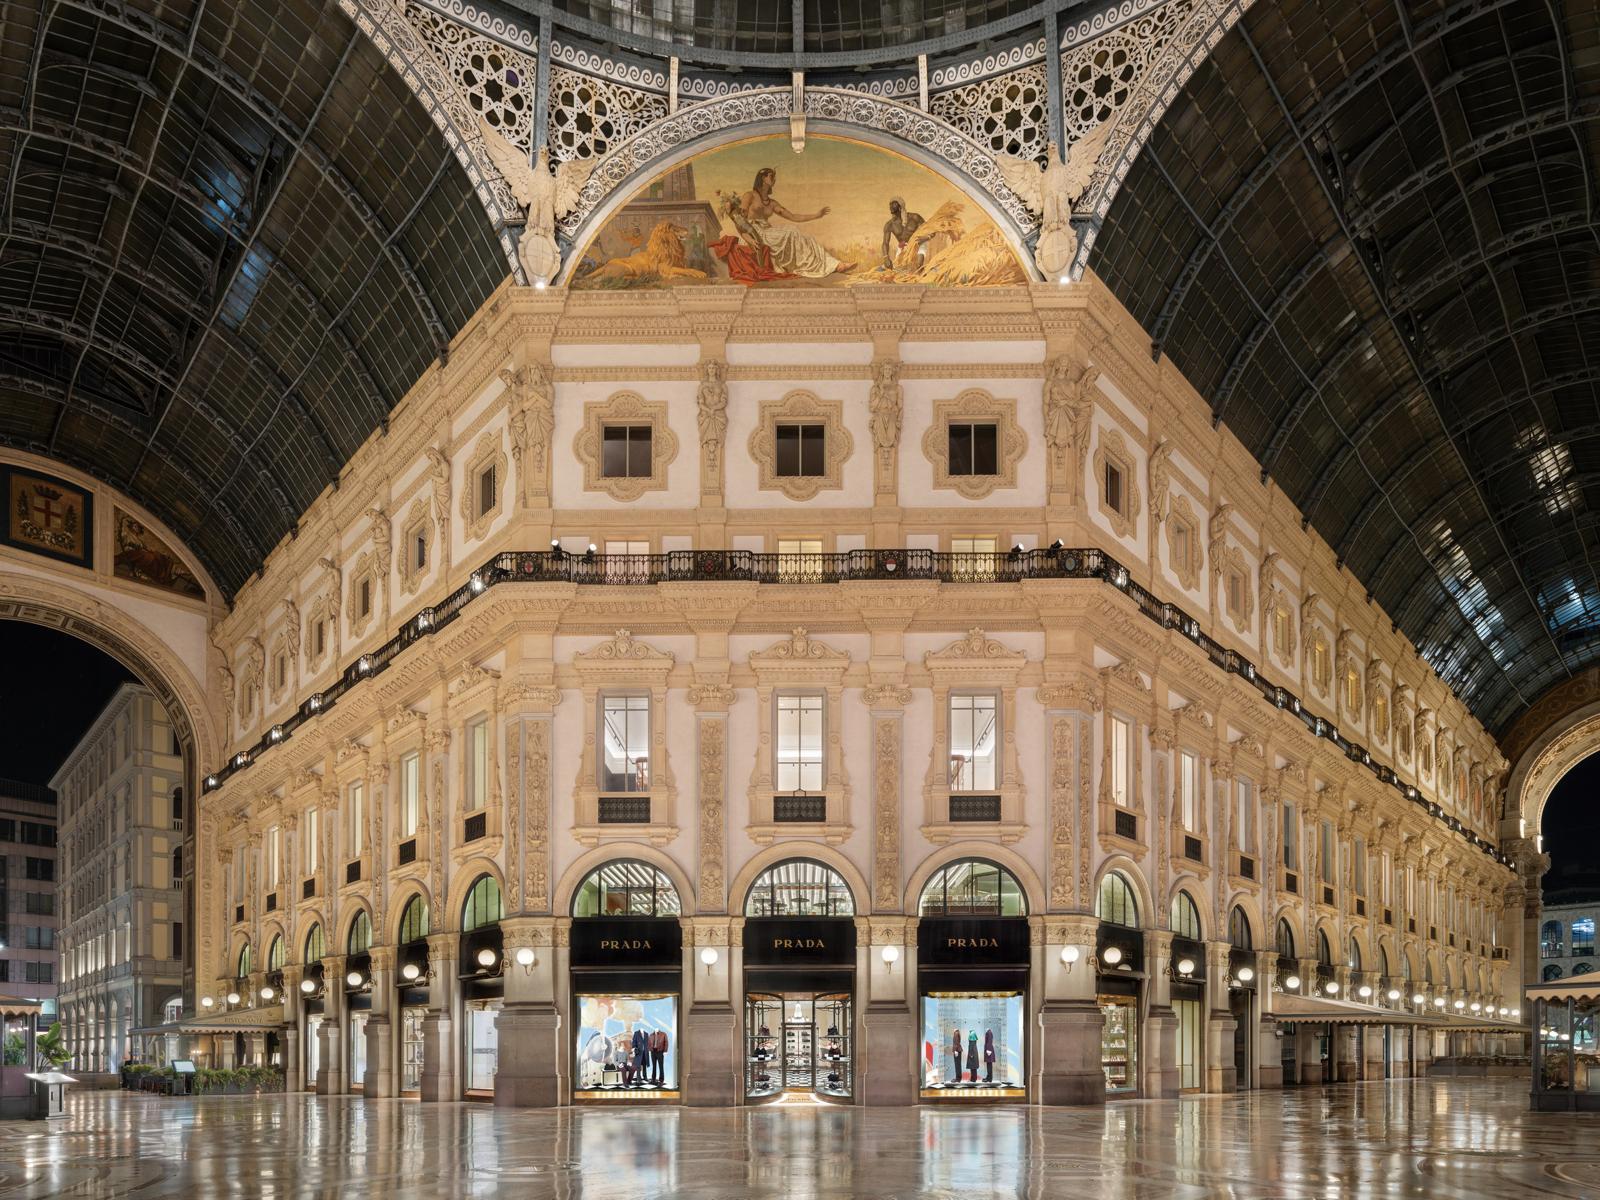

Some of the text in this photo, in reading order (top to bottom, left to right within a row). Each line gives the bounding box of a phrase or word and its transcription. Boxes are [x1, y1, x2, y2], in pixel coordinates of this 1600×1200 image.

[601, 940, 651, 949] PRADA
[774, 939, 825, 949] PRADA
[948, 938, 998, 948] PRADA
